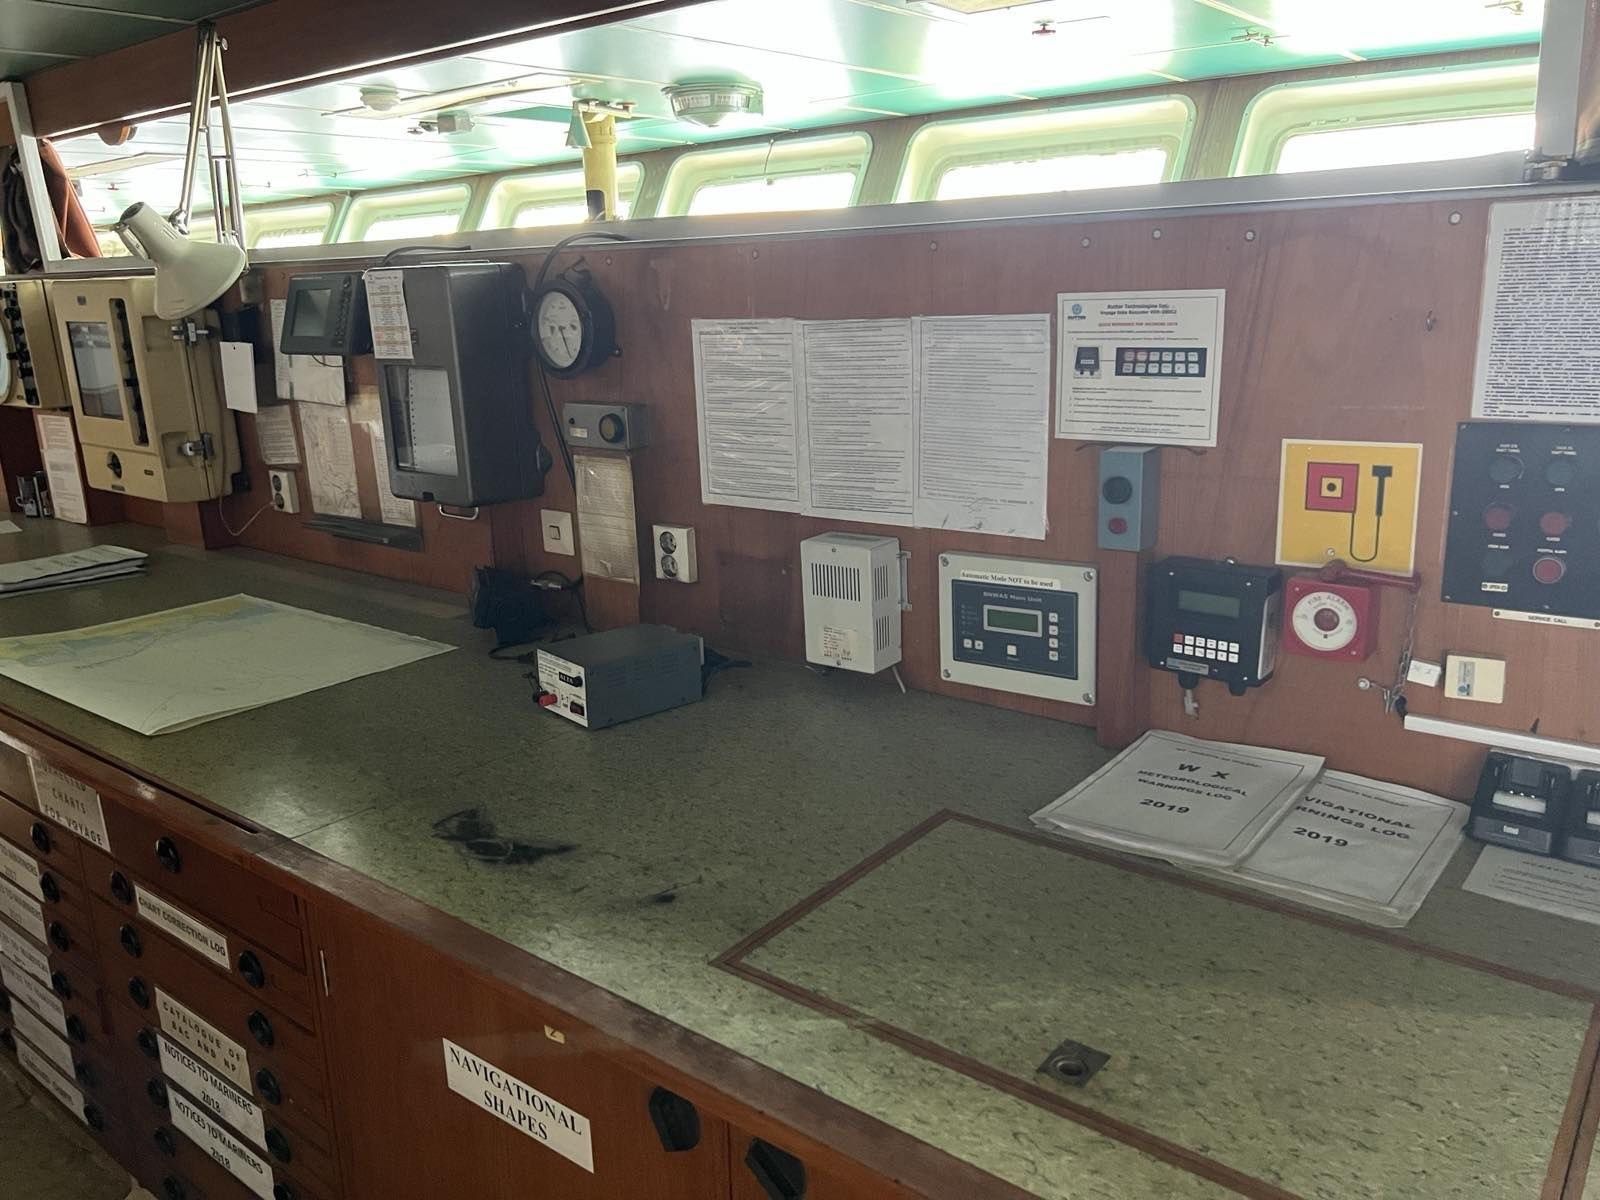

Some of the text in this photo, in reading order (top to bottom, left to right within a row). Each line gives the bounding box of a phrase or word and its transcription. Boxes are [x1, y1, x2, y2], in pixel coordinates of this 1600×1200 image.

[962, 572, 989, 581] Automatic
[991, 574, 1007, 583] Mode
[1307, 595, 1322, 606] FIRE
[1326, 594, 1350, 611] ALARM
[1527, 615, 1551, 623] SERVICE
[1138, 769, 1248, 796] METEOROLOGICAL
[1178, 763, 1230, 779] W X
[52, 784, 87, 814] CHARTS
[1138, 778, 1233, 800] WARNINGS LOG
[1139, 798, 1191, 815] 2019
[1304, 795, 1417, 830] VIGATIONAL
[66, 814, 103, 846] VOYAGE
[1293, 827, 1348, 847] 2019
[1295, 805, 1410, 840] RNINGS LOG
[138, 896, 226, 957] CHART CORRECTION LOG
[163, 1002, 220, 1049] CATALOGUE
[197, 1039, 216, 1059] AND
[164, 1042, 254, 1116] NOTICES TO MARINERS
[449, 1047, 582, 1136] NAVIGATIONAL
[484, 1090, 548, 1141] SHAPES
[174, 1097, 263, 1175] NOTICES TO MARINERS
